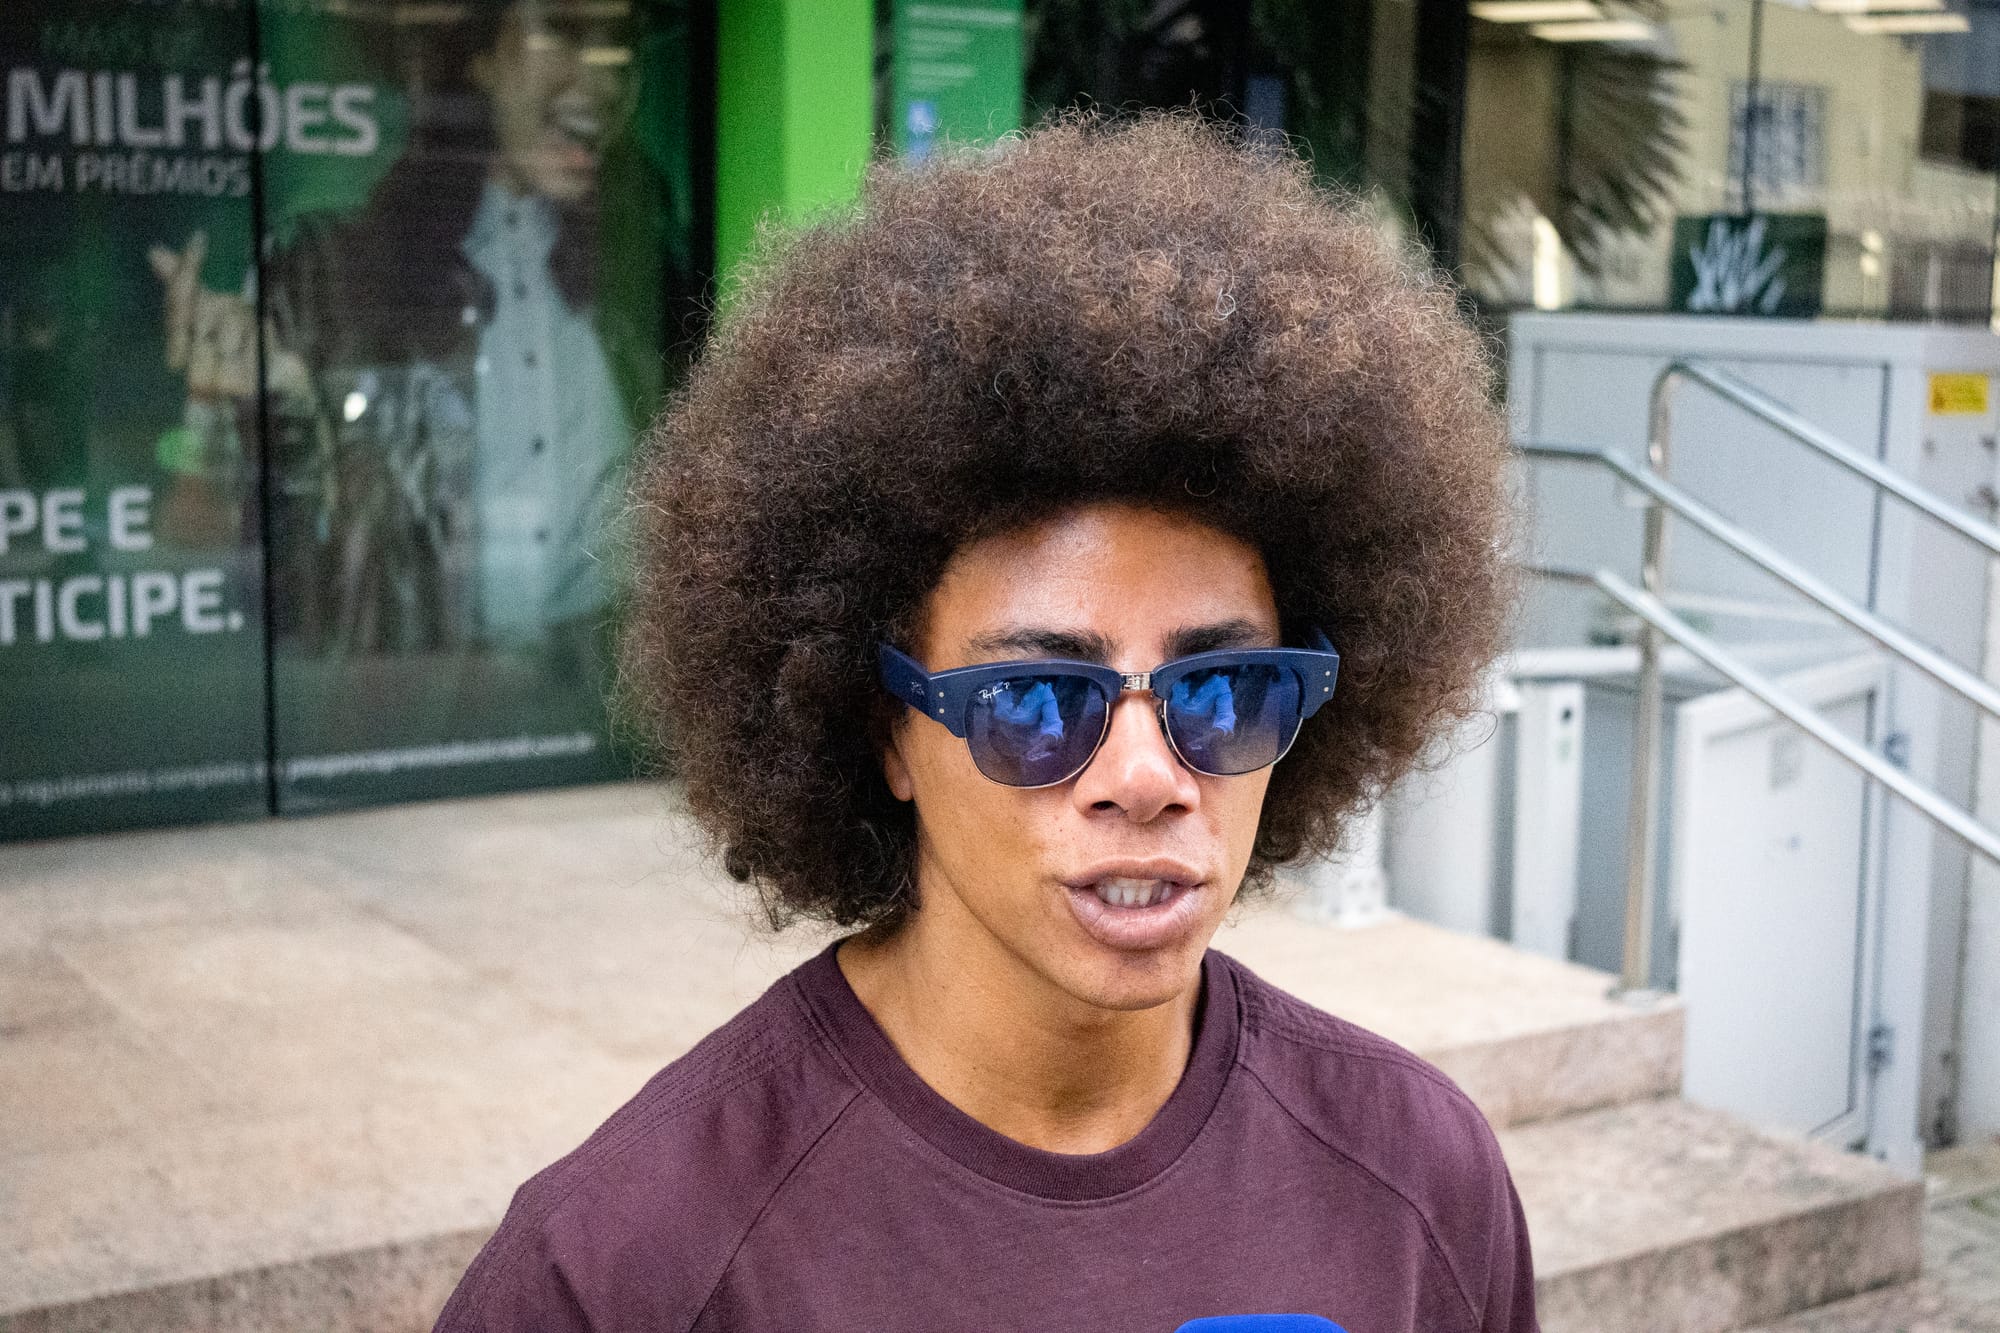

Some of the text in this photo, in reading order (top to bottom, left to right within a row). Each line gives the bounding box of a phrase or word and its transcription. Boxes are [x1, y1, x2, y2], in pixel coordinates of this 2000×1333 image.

[6, 57, 380, 157] MILHÕES
[0, 484, 153, 552] PE E
[0, 567, 246, 645] TICIPE.
